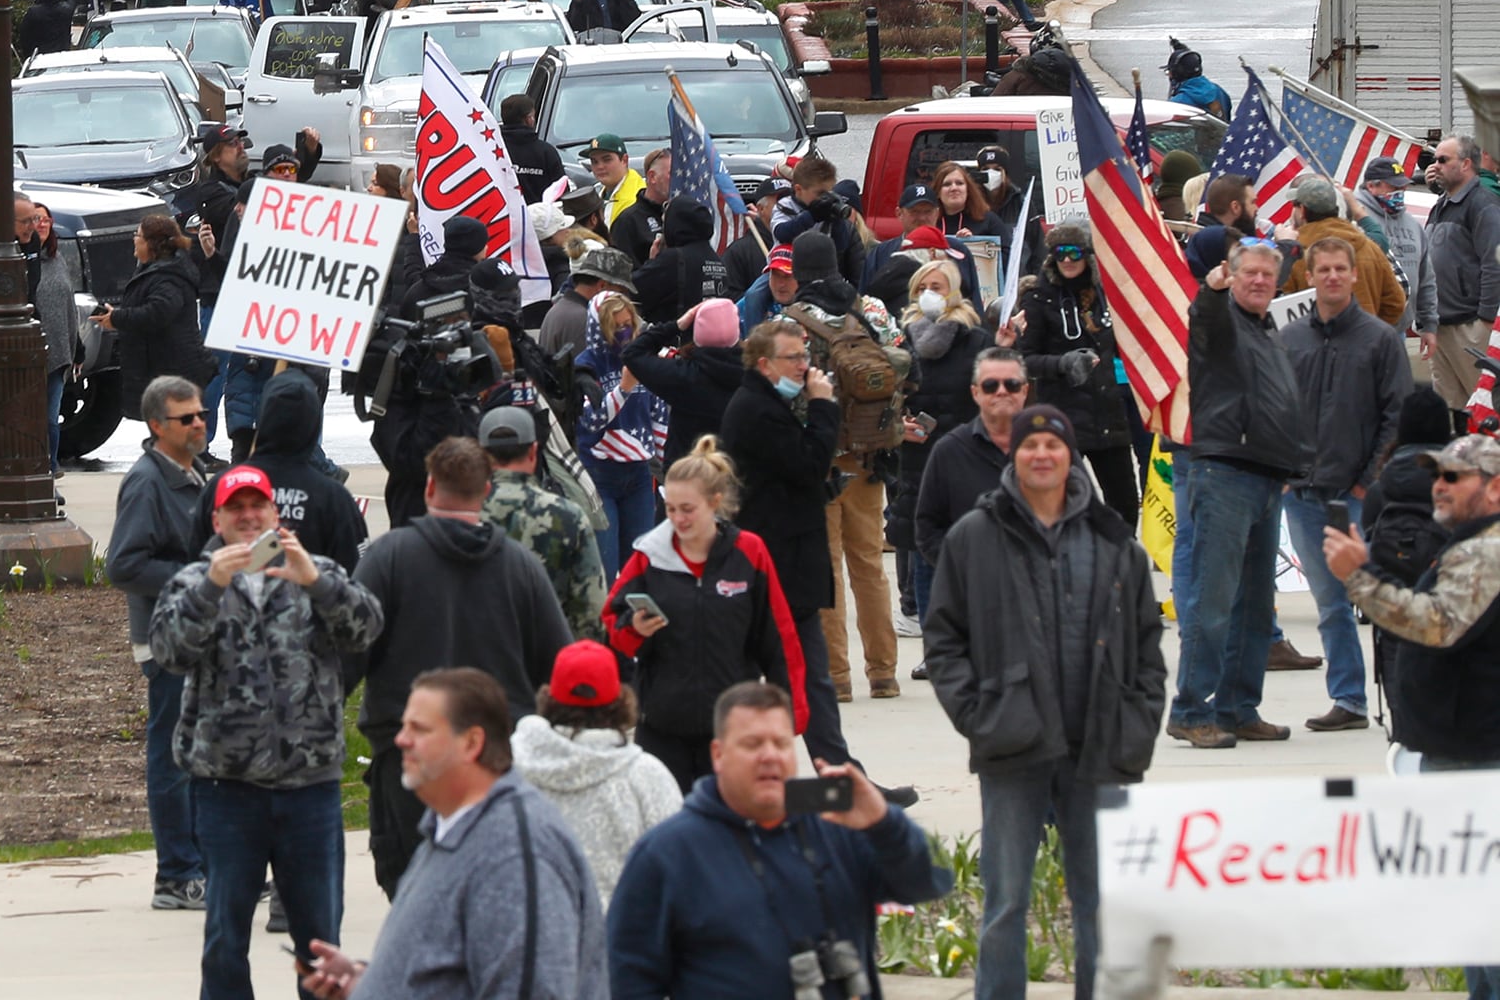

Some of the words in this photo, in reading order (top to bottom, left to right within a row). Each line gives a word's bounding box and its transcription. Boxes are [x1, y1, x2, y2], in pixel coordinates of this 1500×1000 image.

[1039, 110, 1065, 124] Give
[1055, 165, 1079, 182] Giv
[255, 185, 381, 247] RECALL
[237, 242, 381, 306] WHITMER
[241, 301, 363, 367] NOW!
